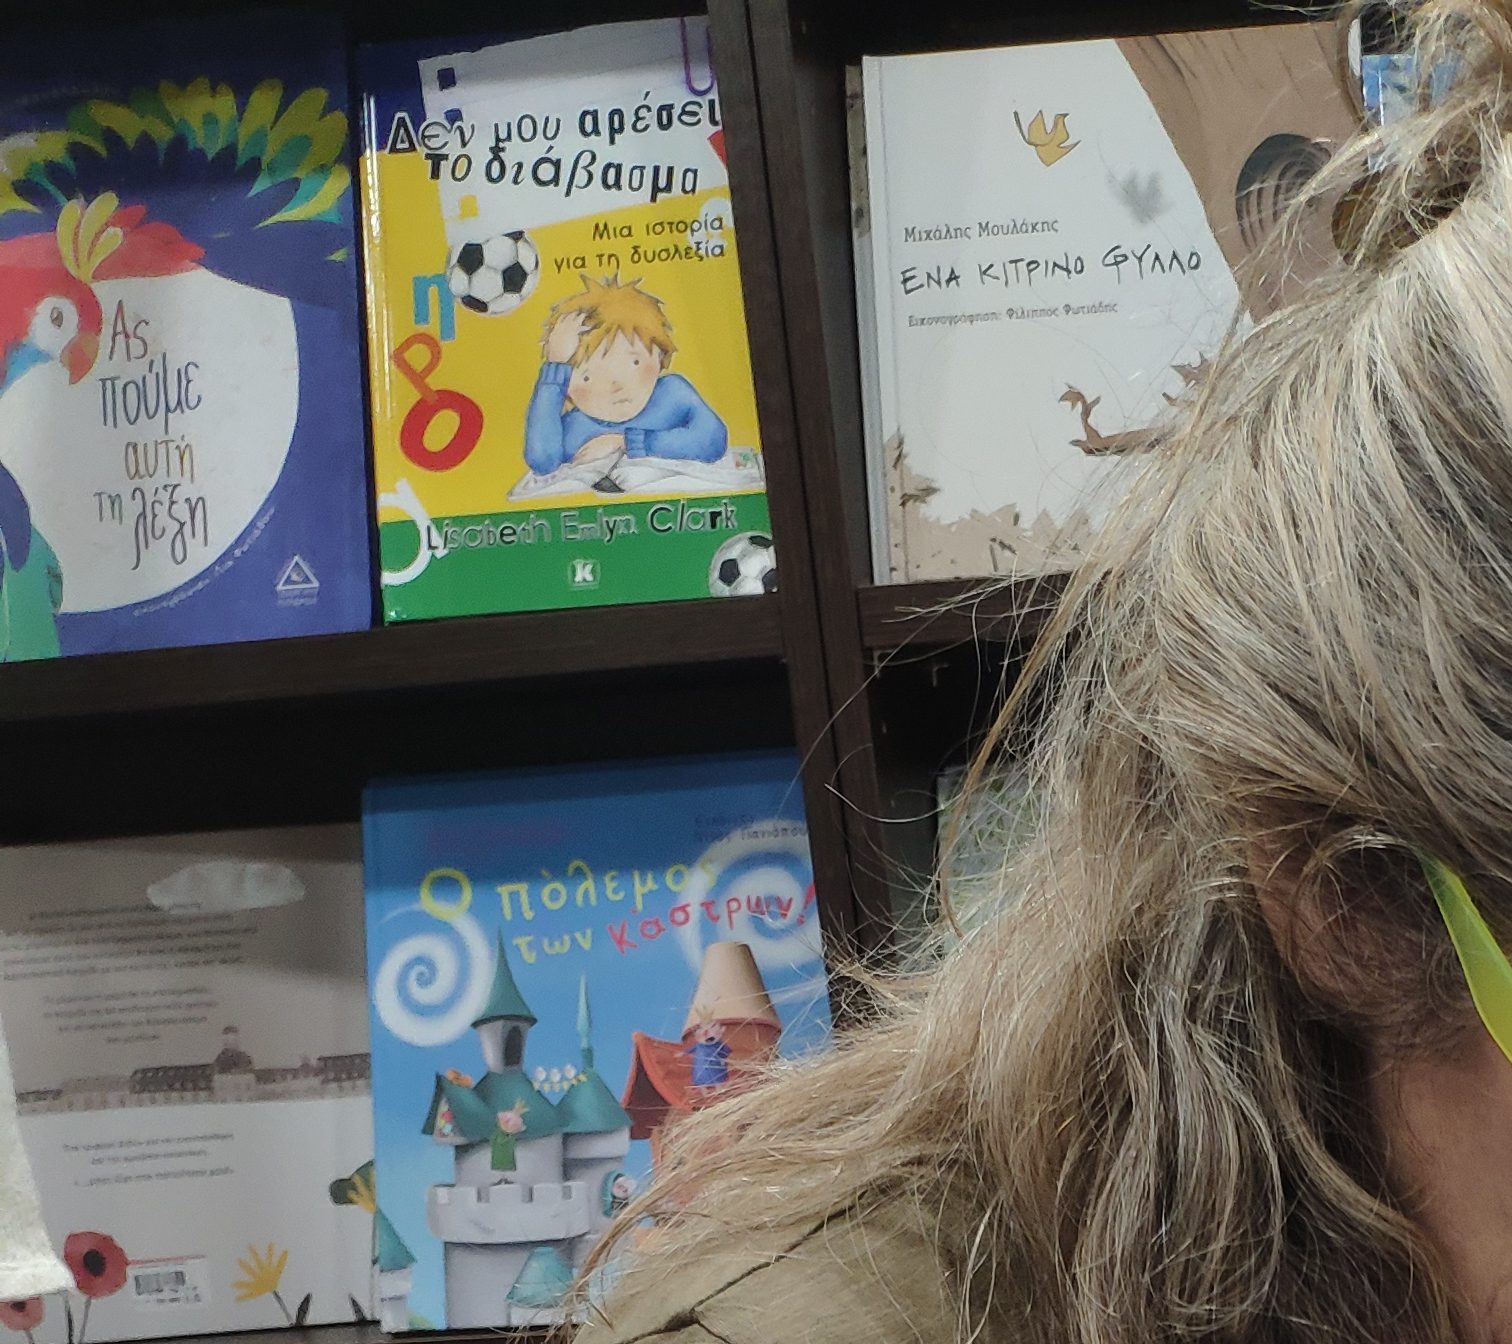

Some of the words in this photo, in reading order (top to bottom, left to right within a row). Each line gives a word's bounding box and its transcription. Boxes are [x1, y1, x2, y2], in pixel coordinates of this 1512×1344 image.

[387, 111, 475, 154] Δεν
[494, 113, 561, 148] μου
[578, 91, 720, 146] αρέσει
[425, 152, 472, 182] το
[485, 143, 699, 203] διάβασμα
[592, 221, 634, 241] Μια
[645, 213, 724, 241] ιστορία
[903, 222, 972, 243] Μιχάλης
[977, 217, 1060, 240] Μουλάκης
[554, 255, 587, 273] για
[595, 252, 620, 270] τη
[630, 239, 726, 266] δυσλεξία
[899, 266, 962, 296] ΕΝΑ
[977, 253, 1086, 287] ΚΙΤΡΙΝΟ
[1102, 244, 1203, 283] ΦΥΛΛΟ
[109, 299, 150, 362] Ας
[100, 352, 202, 435] πούμε
[125, 434, 194, 483] αυτή
[95, 491, 123, 525] τη
[131, 484, 209, 570] λέξη
[648, 497, 738, 534] Clark
[420, 866, 473, 921] Ο
[513, 927, 592, 964] των
